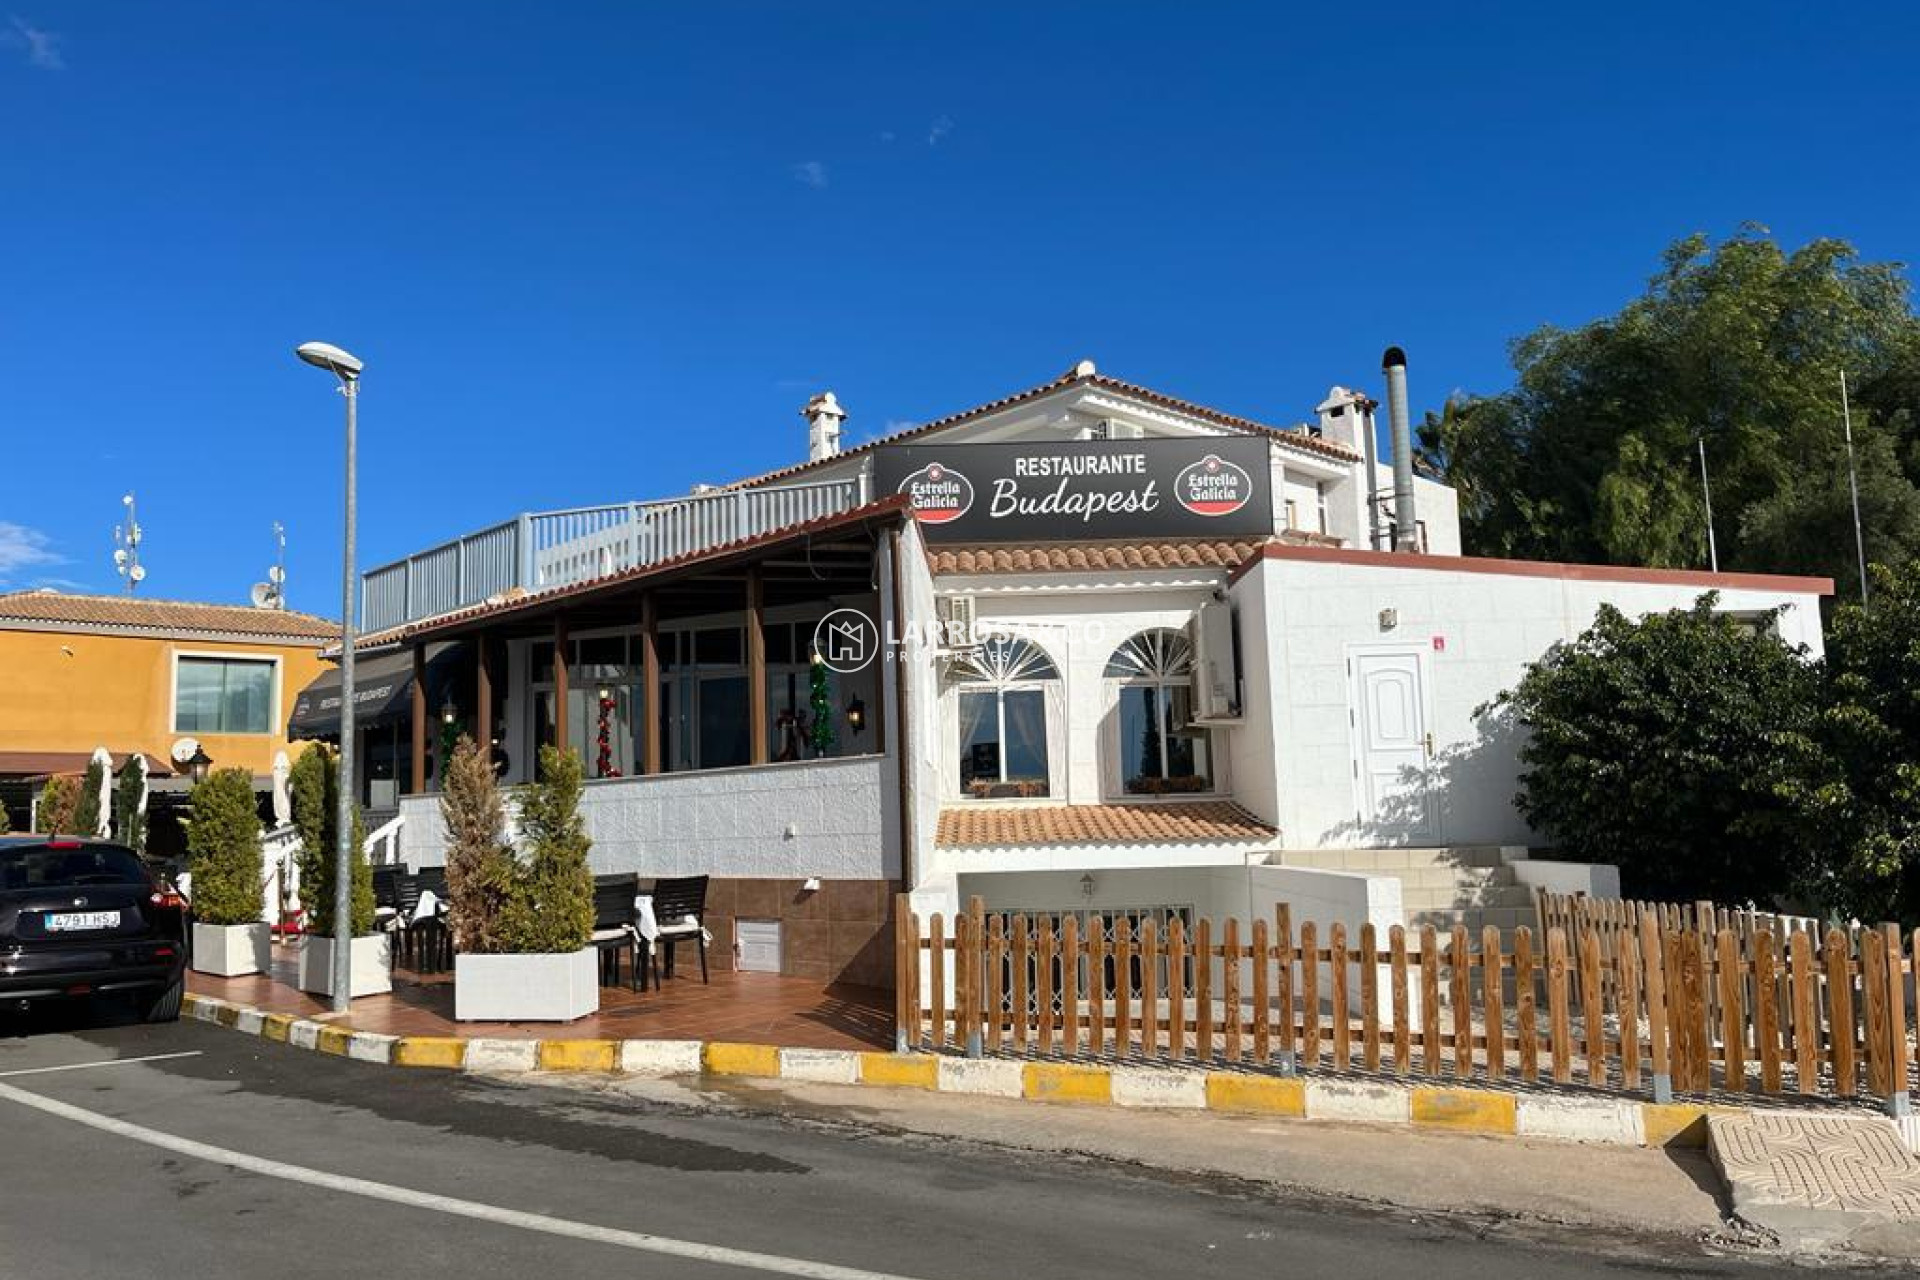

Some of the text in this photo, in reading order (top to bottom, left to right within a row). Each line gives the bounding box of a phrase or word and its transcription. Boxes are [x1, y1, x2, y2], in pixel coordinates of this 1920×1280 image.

[1015, 454, 1146, 477] RESTAURANTE
[1188, 473, 1238, 487] Estrella
[911, 481, 960, 494] Estrella
[1190, 487, 1236, 500] Galicia
[912, 494, 959, 508] Galicia
[989, 476, 1160, 523] Budapest
